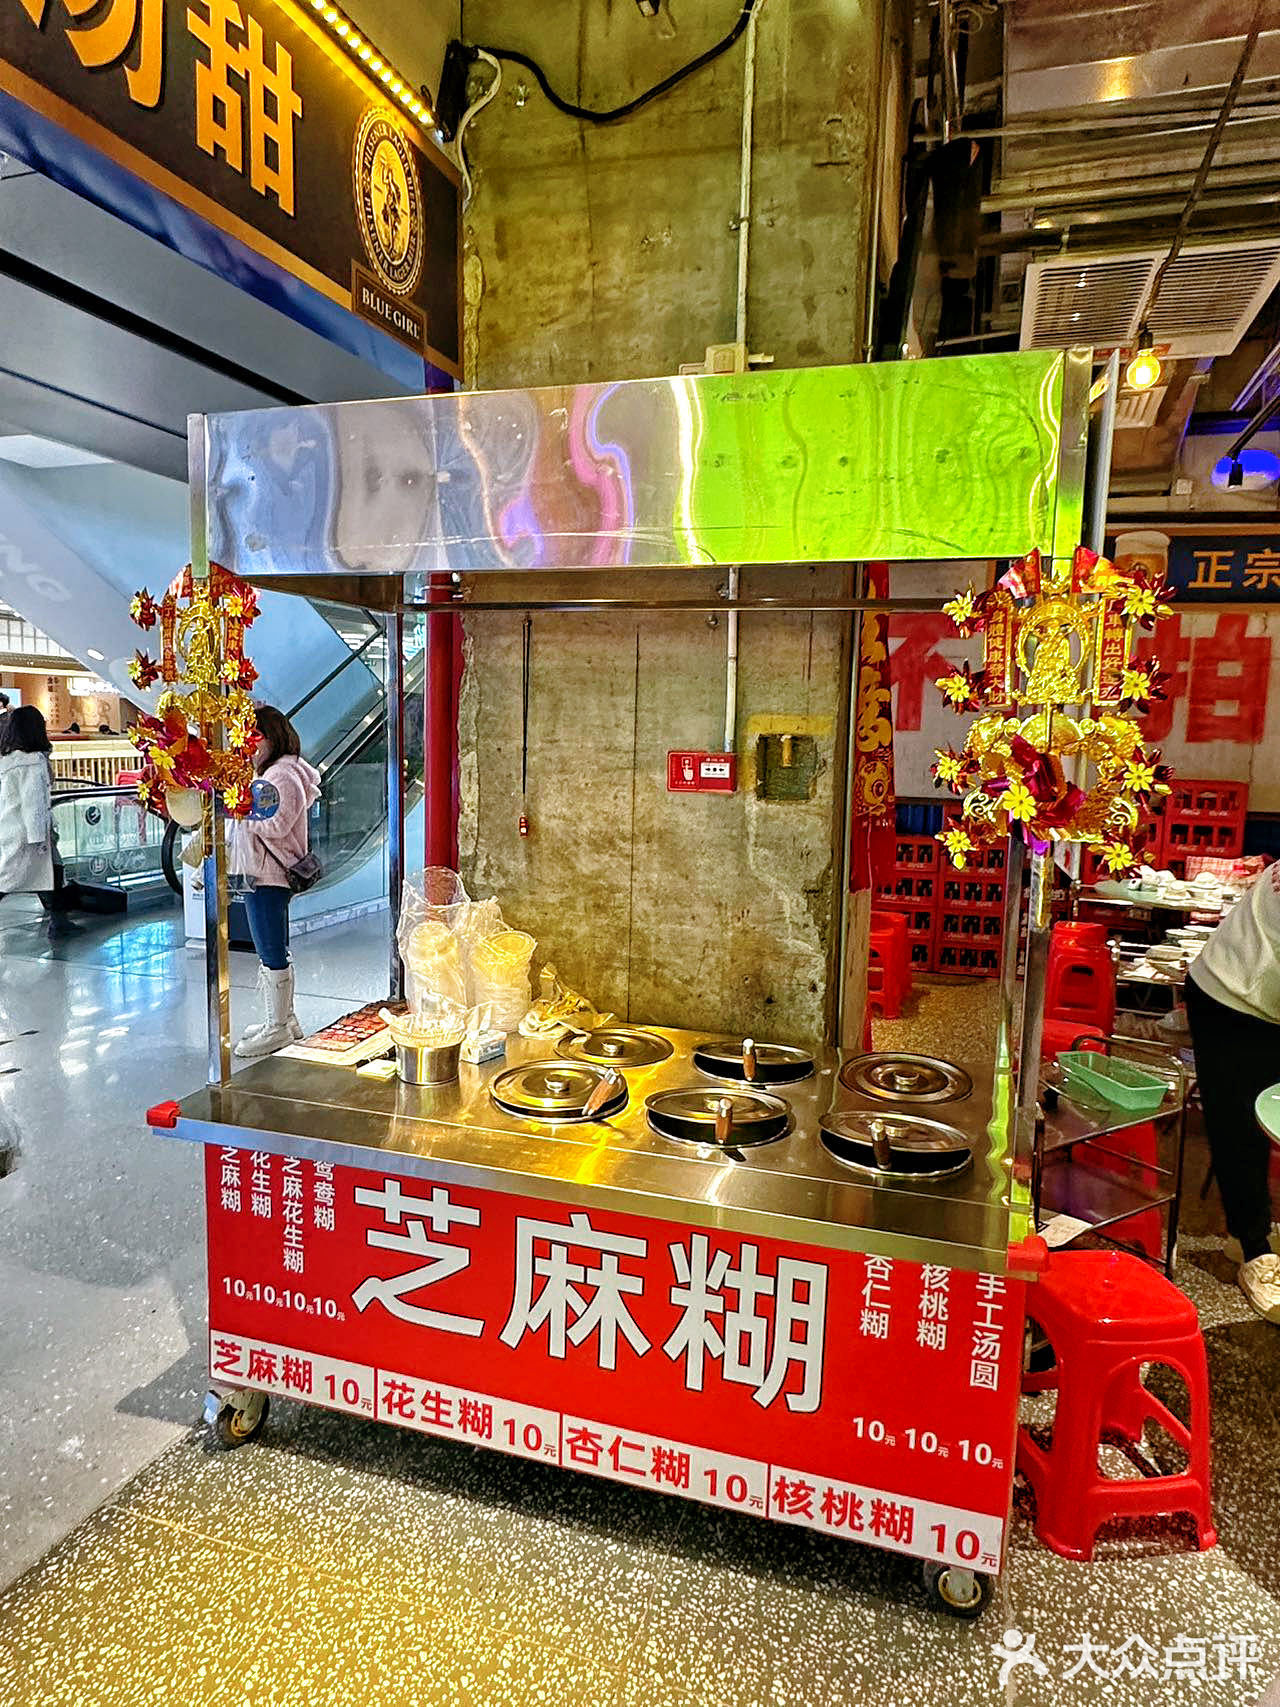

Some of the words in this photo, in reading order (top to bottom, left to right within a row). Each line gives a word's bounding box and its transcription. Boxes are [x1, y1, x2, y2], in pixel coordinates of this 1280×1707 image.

[362, 287, 392, 322] BLUE
[393, 309, 420, 340] GIRL
[1187, 548, 1280, 589] 正宗
[352, 1178, 828, 1413] 芝麻糊
[915, 1262, 952, 1351] 核桃糊
[969, 1271, 1007, 1391] 手工汤圆
[213, 1338, 313, 1395] 芝麻糊
[324, 1374, 372, 1411] 10元
[381, 1379, 493, 1440] 花生糊
[503, 1417, 557, 1458] 10元
[853, 1416, 896, 1446] 10元
[904, 1427, 949, 1458] 10元
[958, 1439, 1004, 1469] 10元
[565, 1426, 691, 1489] 杏仁糊
[703, 1469, 764, 1510] 10元
[772, 1475, 914, 1546] 核桃糊
[930, 1523, 998, 1567] 10元
